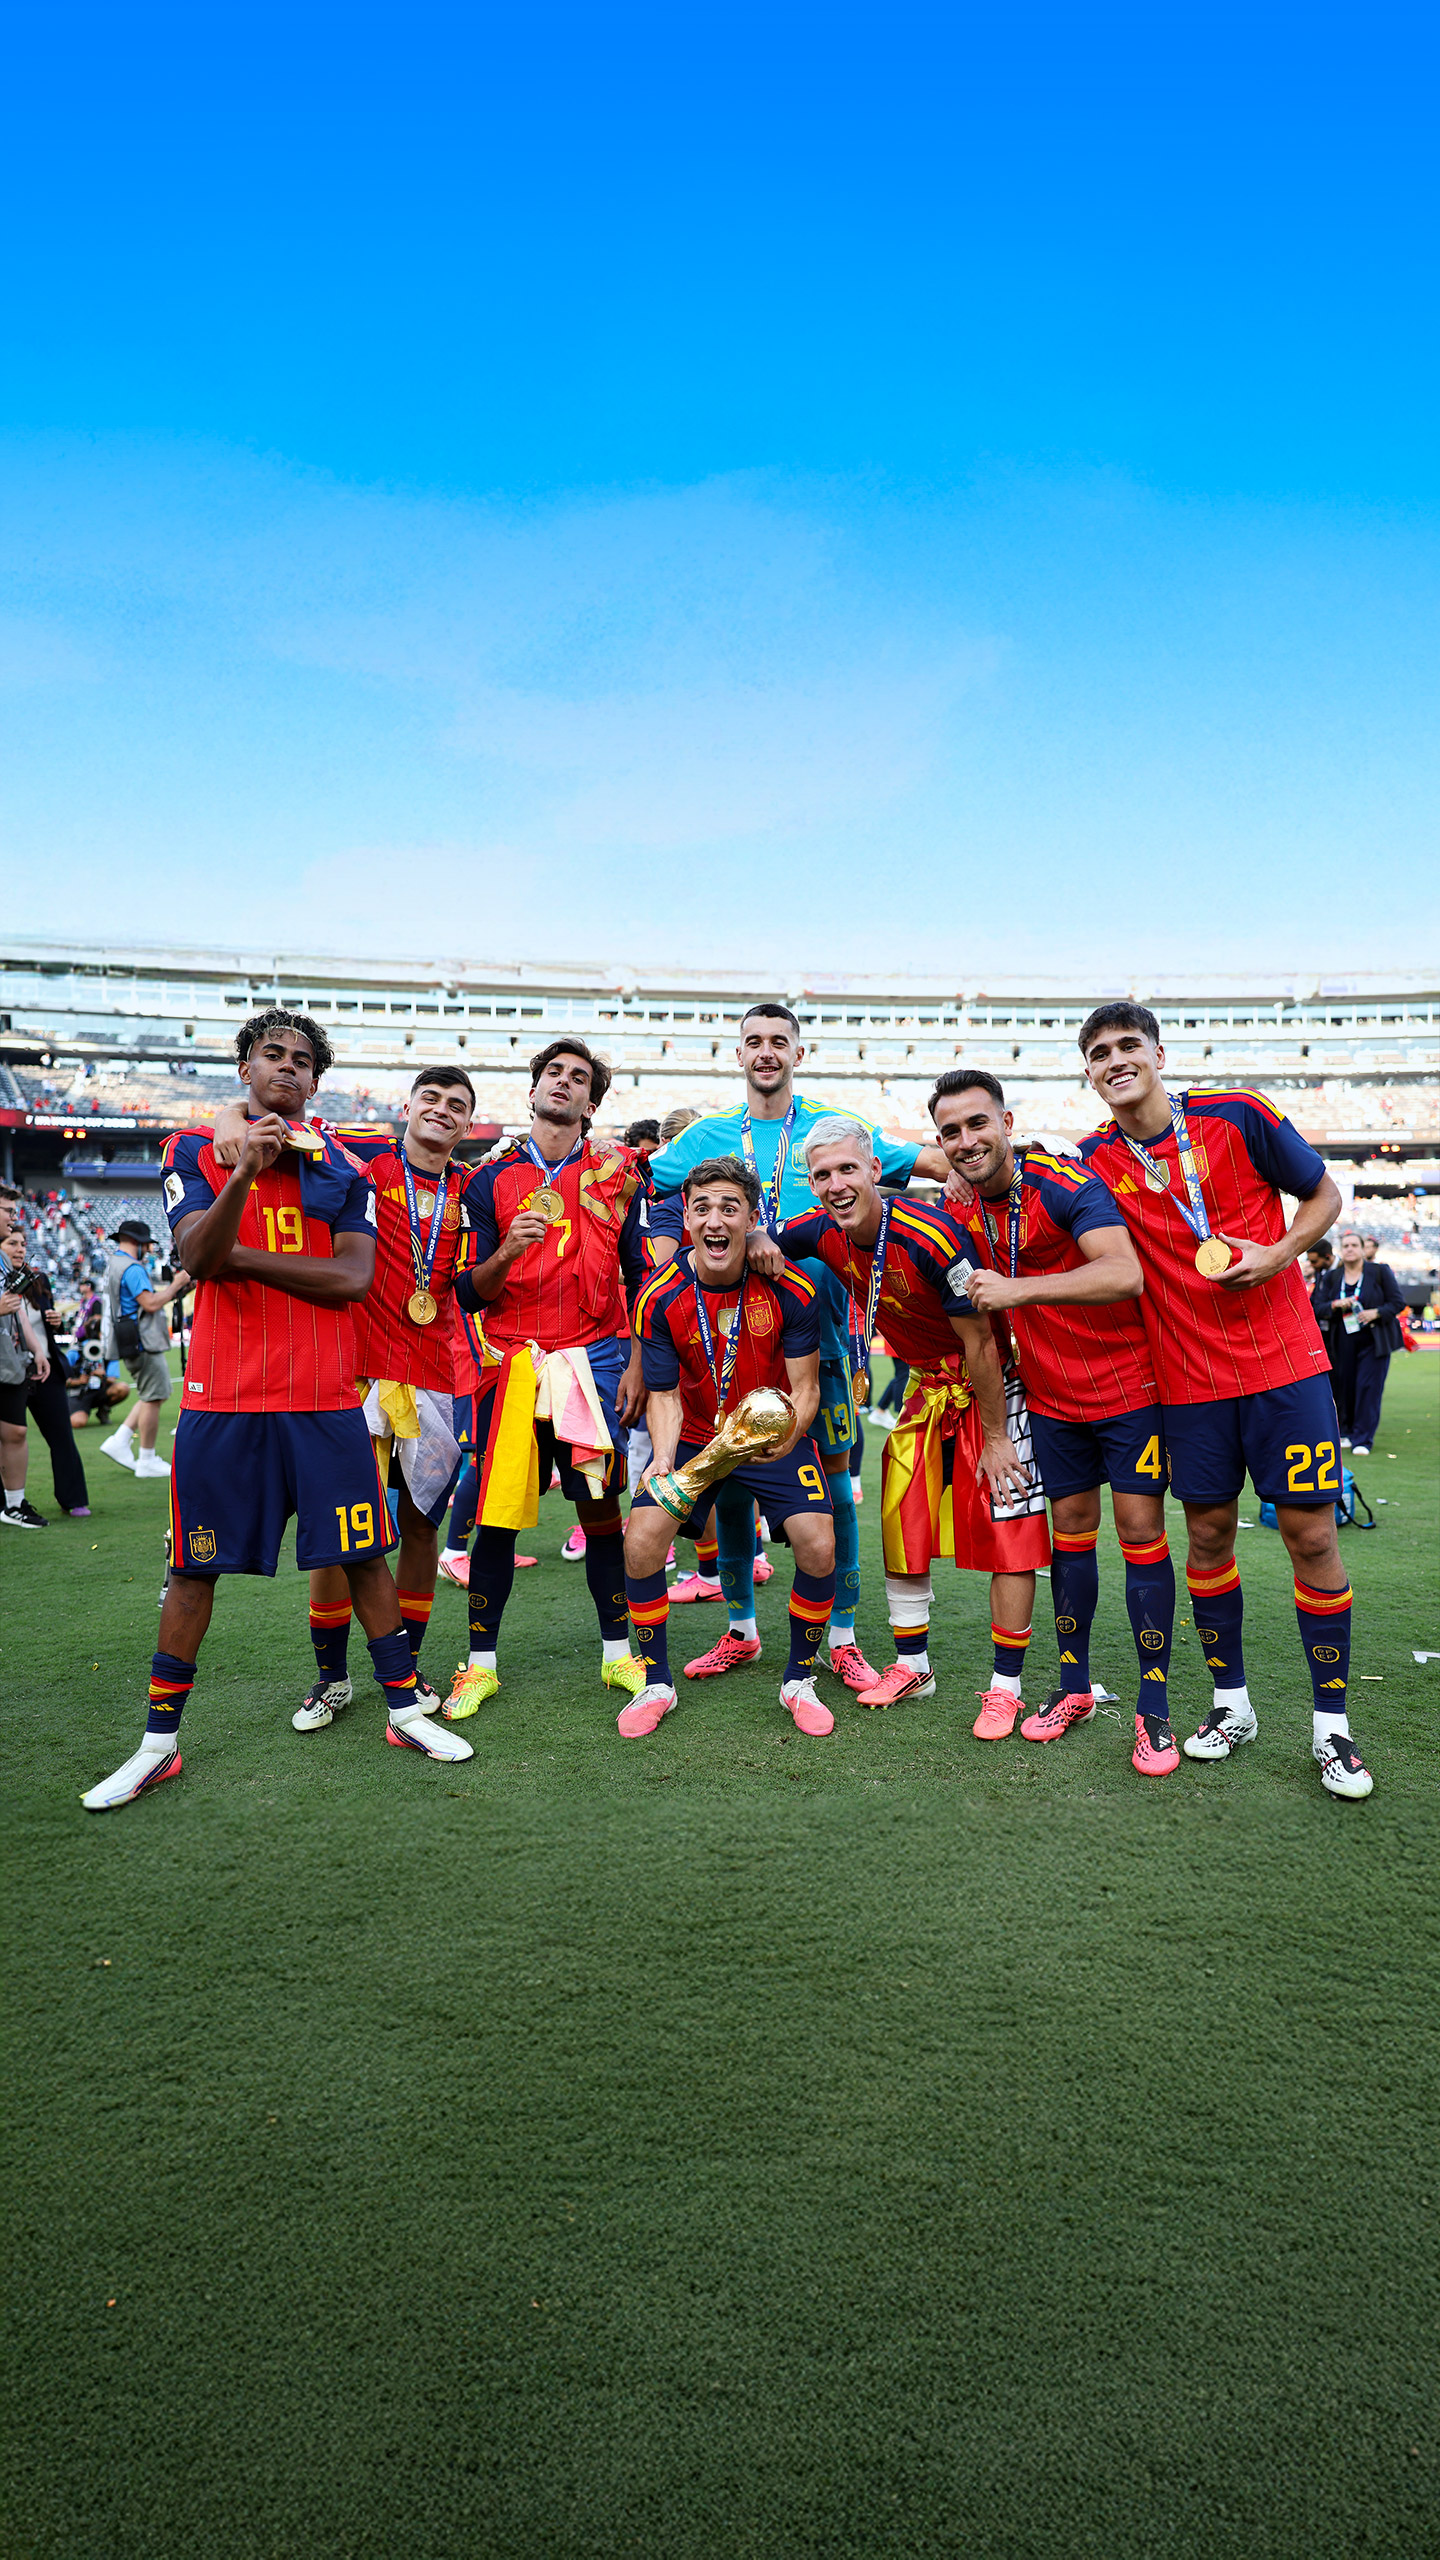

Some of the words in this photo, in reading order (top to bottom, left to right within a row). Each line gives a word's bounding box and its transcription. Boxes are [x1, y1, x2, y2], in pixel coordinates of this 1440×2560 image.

[408, 1190, 416, 1212] WORLD
[434, 1204, 443, 1226] WORLD
[262, 1206, 303, 1252] 19
[879, 1217, 887, 1241] WORLD
[1197, 1211, 1205, 1227] FIFA
[552, 1219, 572, 1257] 7
[877, 1241, 885, 1256] FIFA
[697, 1304, 705, 1317] CUP
[700, 1317, 710, 1341] WORLD
[821, 1403, 851, 1445] 13
[1135, 1435, 1162, 1479] 4
[1285, 1441, 1339, 1492] 22
[797, 1464, 825, 1501] 9
[335, 1502, 375, 1552] 19
